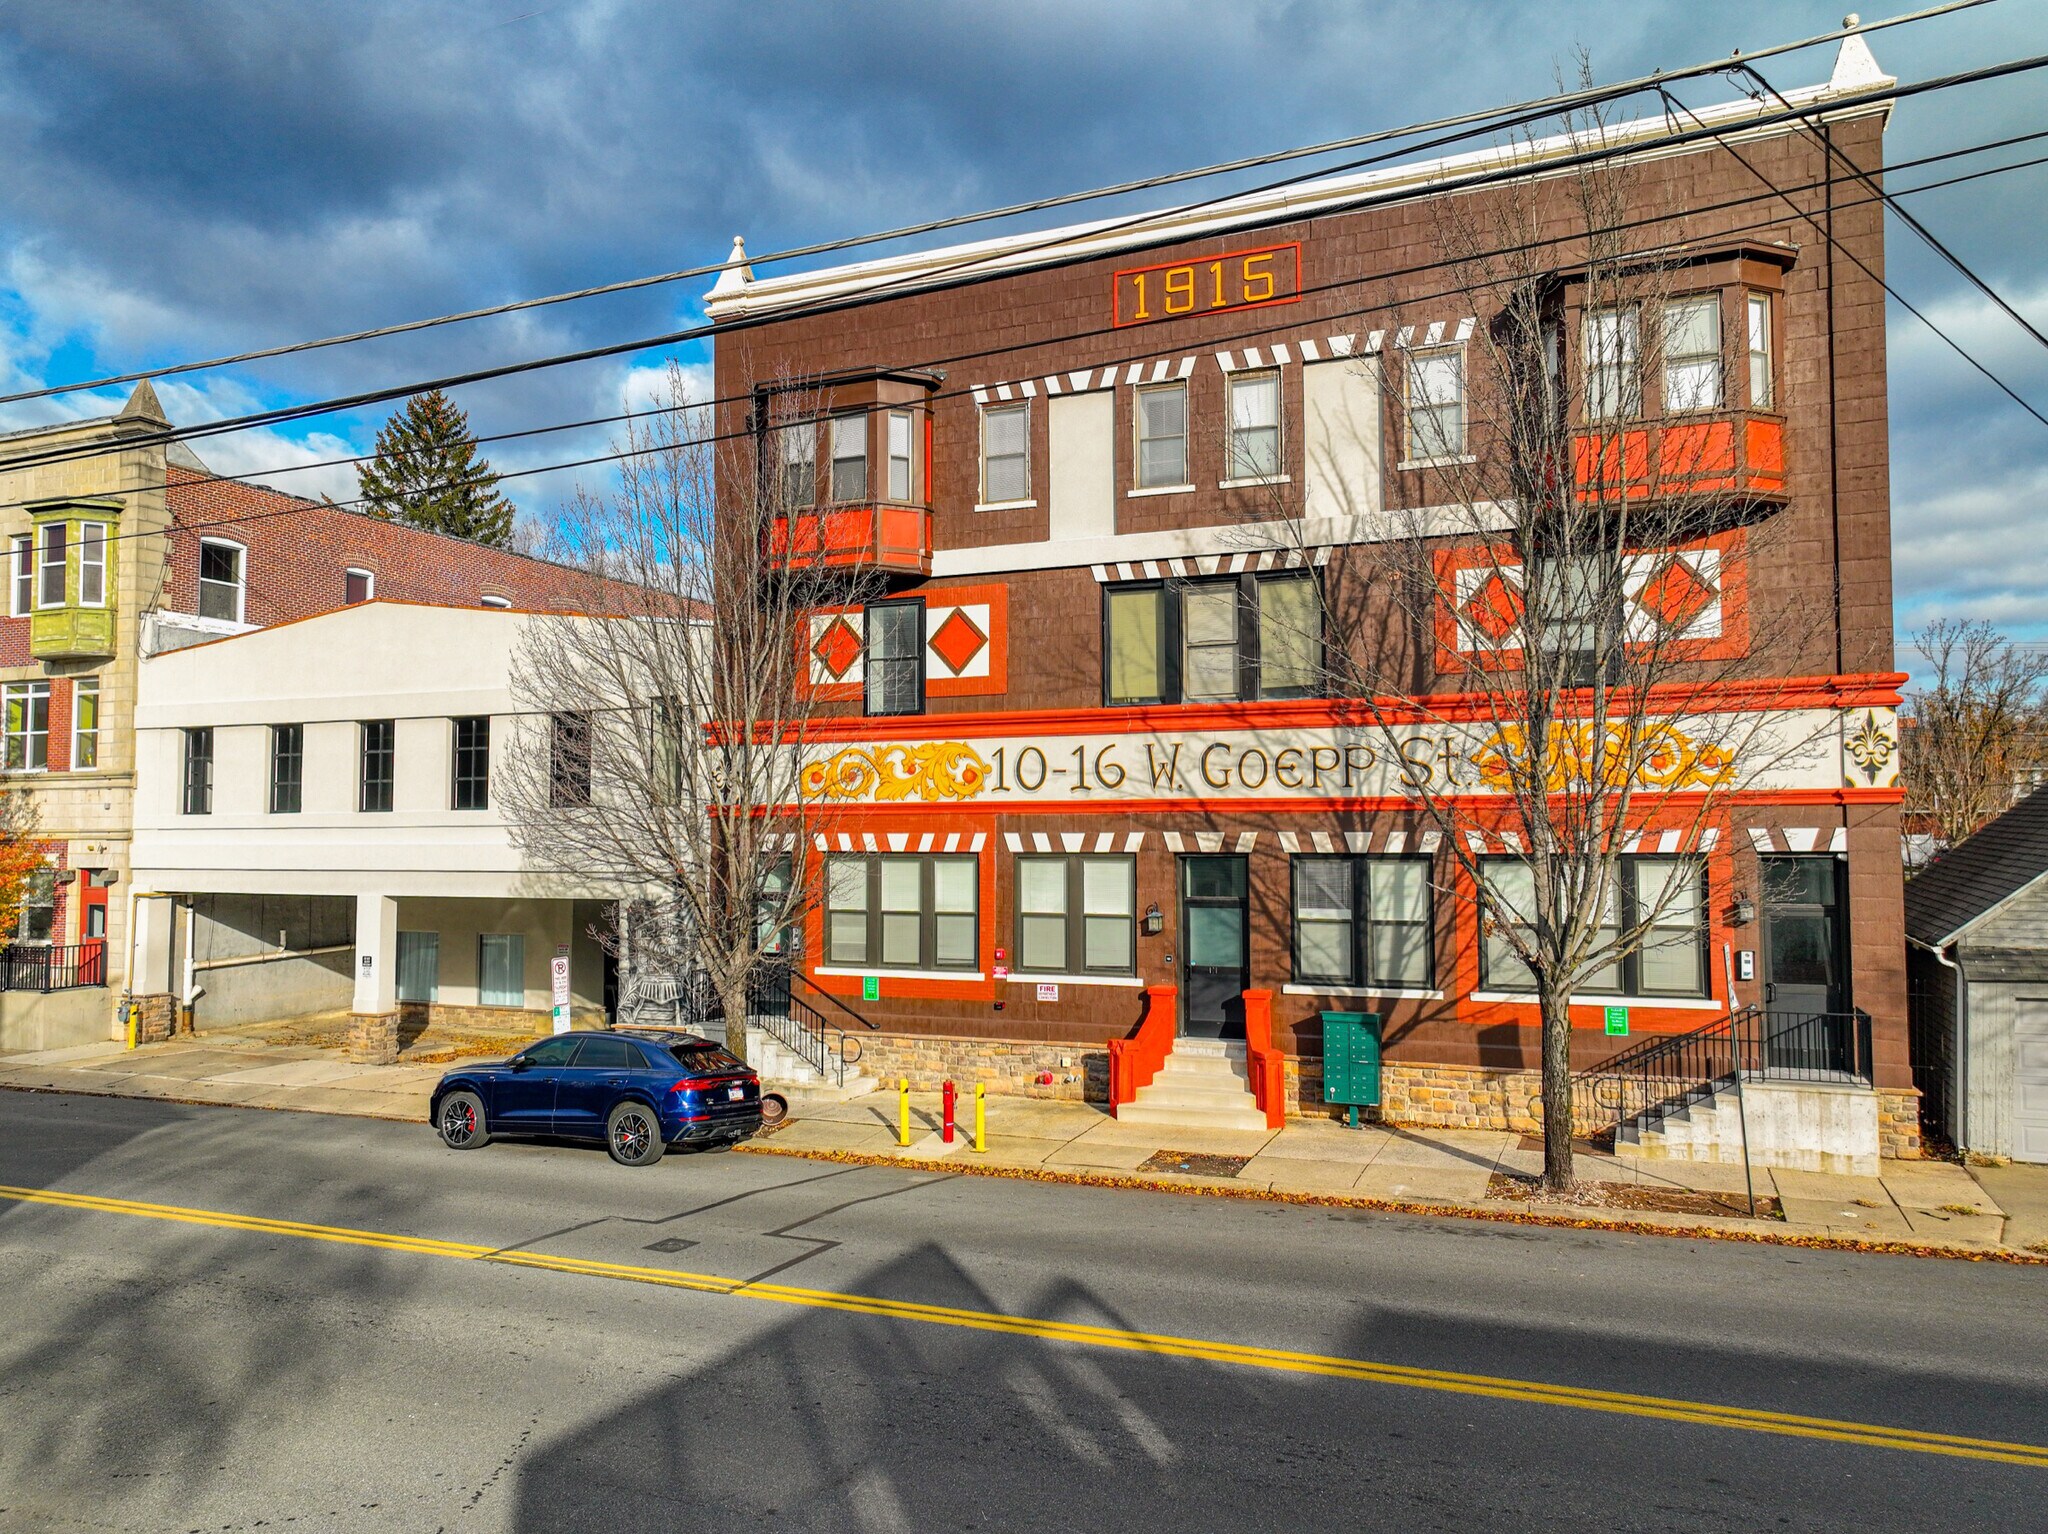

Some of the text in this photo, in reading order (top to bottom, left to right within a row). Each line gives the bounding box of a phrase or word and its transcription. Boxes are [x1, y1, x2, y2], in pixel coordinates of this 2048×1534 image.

[1133, 253, 1274, 320] 1915
[991, 744, 1126, 792] 10-16
[1143, 742, 1184, 792] W.
